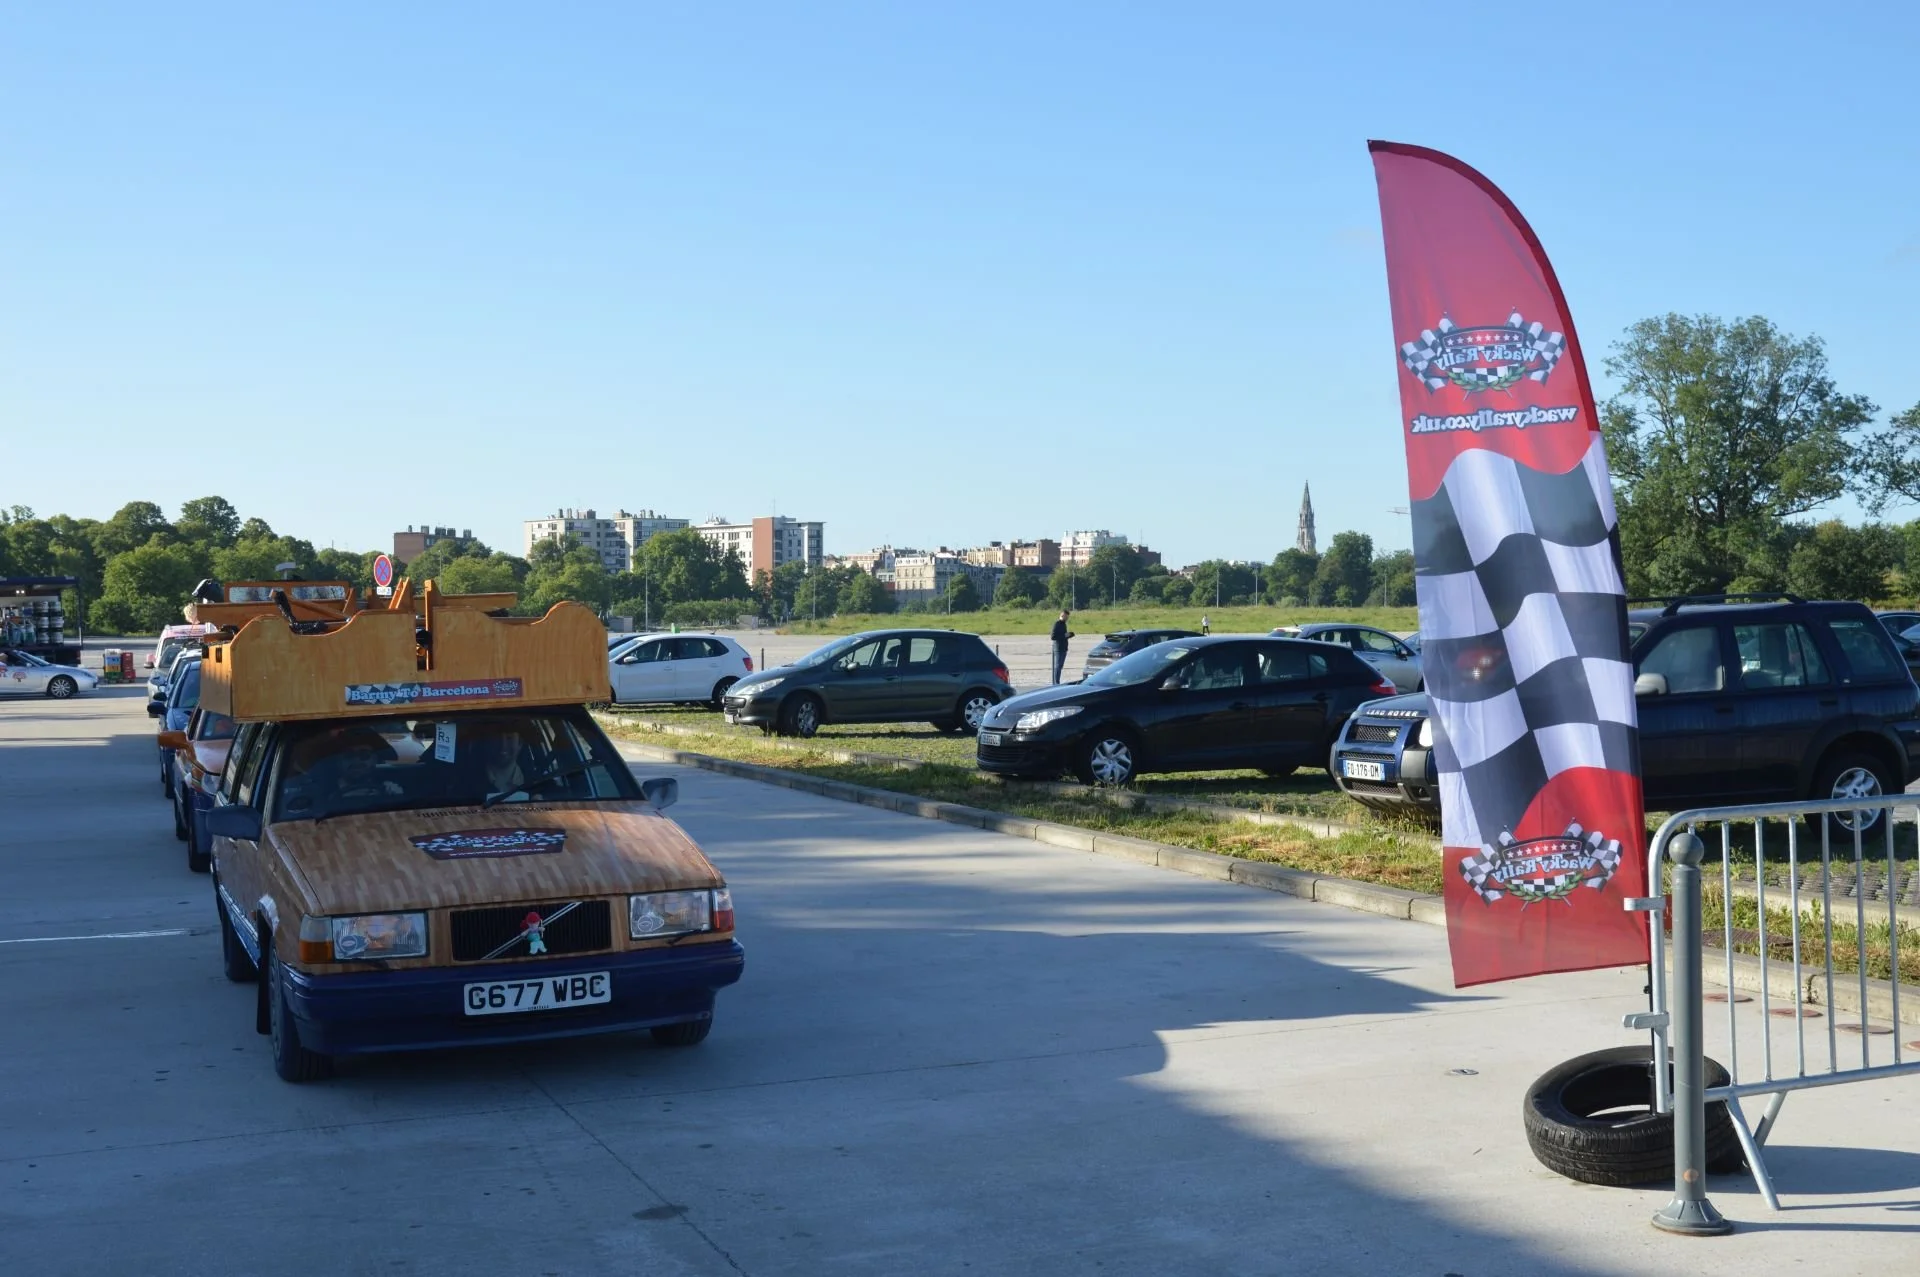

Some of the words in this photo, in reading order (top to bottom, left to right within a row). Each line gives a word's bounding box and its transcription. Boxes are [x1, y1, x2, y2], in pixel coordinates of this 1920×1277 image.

[351, 688, 397, 702] Barmy
[399, 687, 419, 698] To
[422, 685, 490, 697] Barcelona
[468, 981, 544, 1010] G677
[552, 974, 606, 1003] WBC
